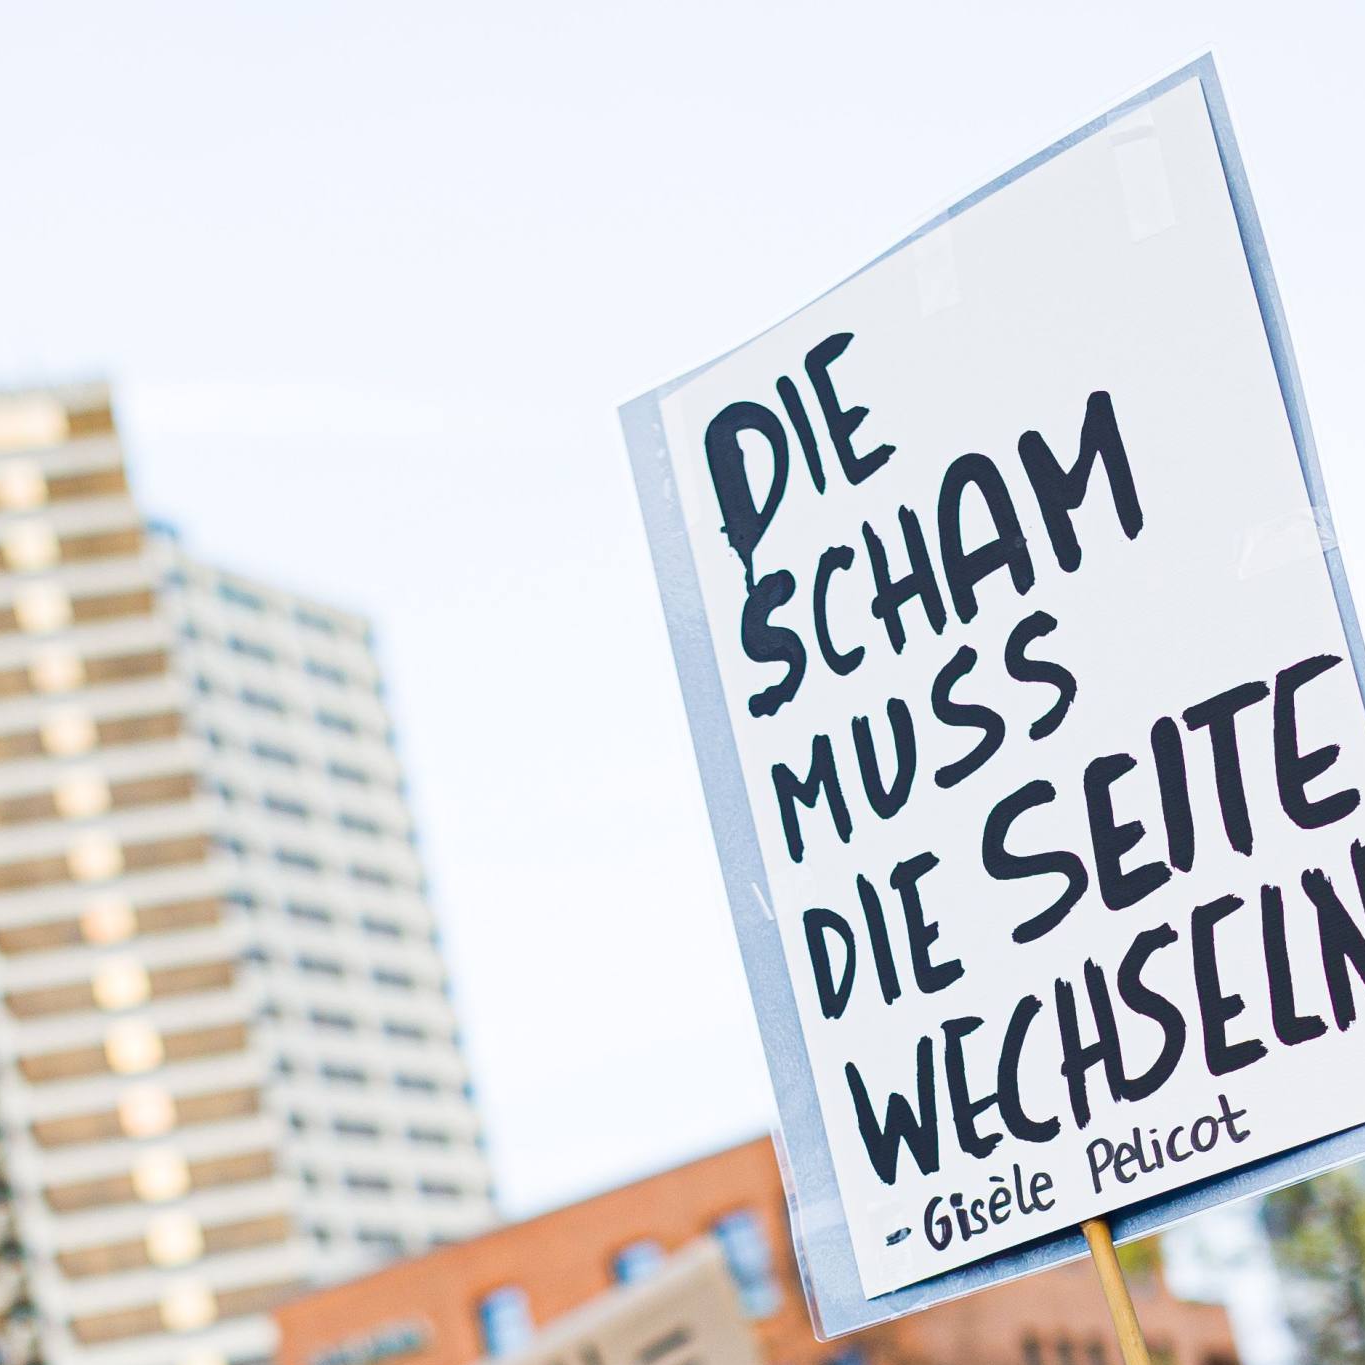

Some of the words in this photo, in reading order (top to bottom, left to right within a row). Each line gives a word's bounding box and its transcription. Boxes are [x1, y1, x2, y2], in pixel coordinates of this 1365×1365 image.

[703, 331, 898, 552] DIE
[739, 389, 1145, 720] SCHAM
[771, 609, 1078, 864] MUSS
[802, 850, 967, 1021] DIE
[981, 653, 1363, 945] SEITE
[1085, 1093, 1251, 1195] Pelicot
